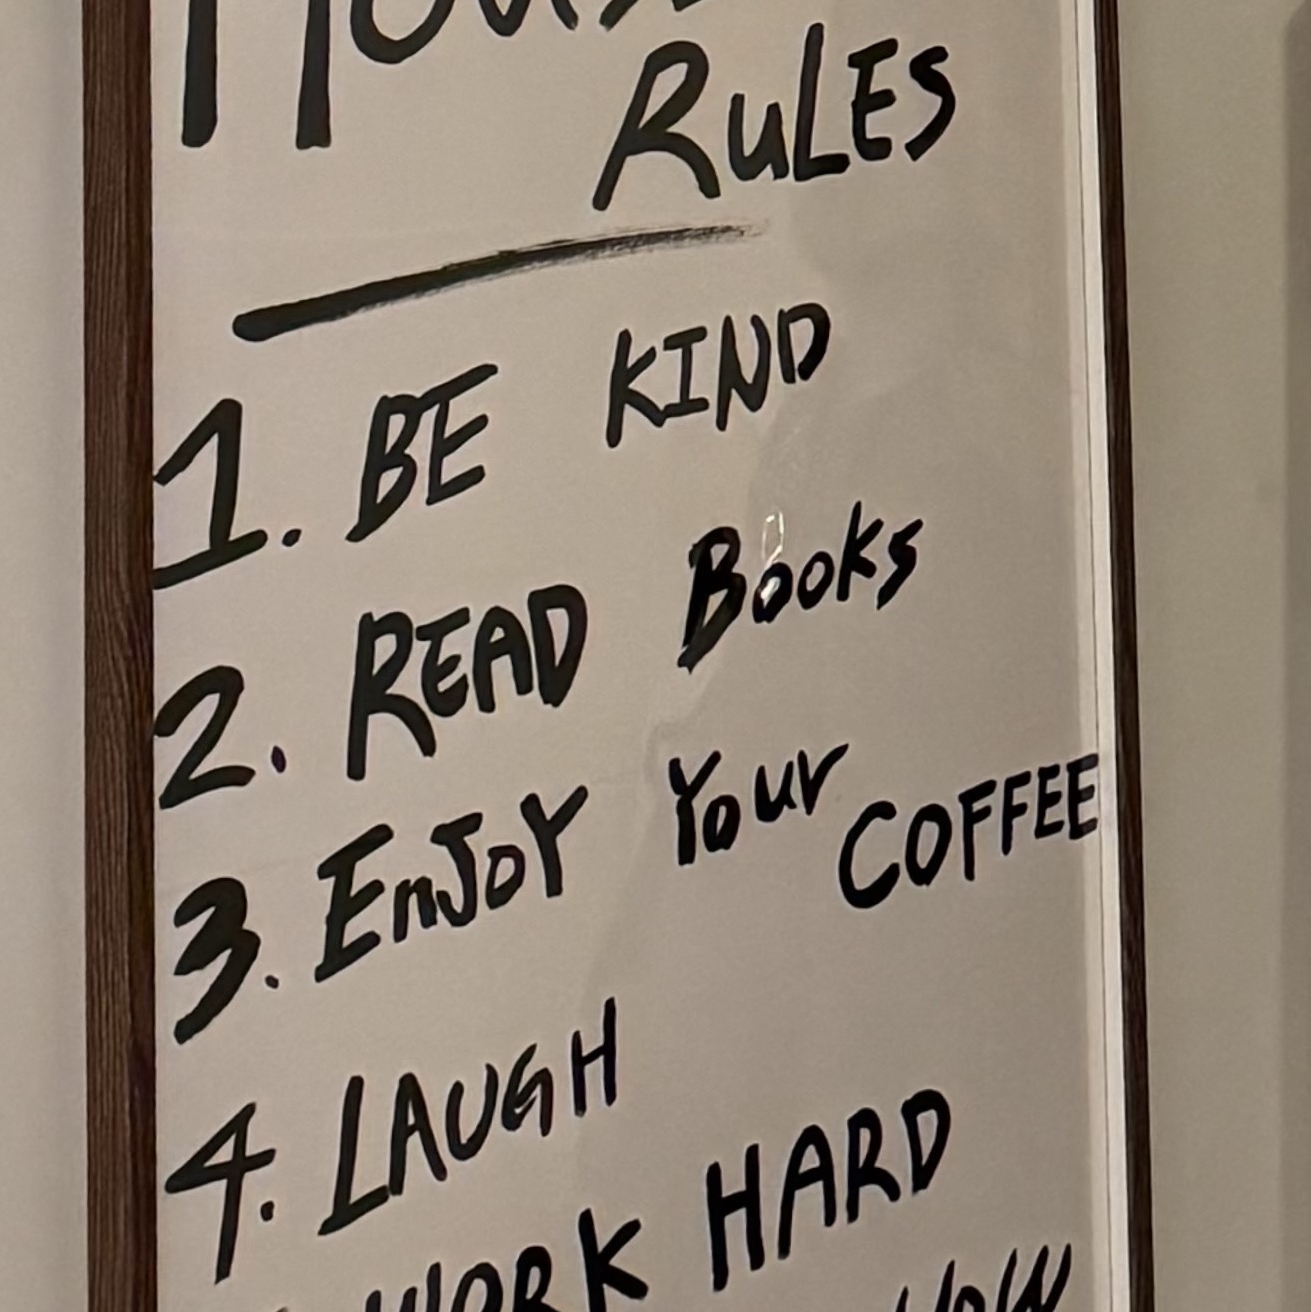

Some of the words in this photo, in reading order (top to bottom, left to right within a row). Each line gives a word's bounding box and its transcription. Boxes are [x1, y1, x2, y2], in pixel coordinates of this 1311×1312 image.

[154, 400, 301, 590] 1.
[346, 364, 498, 542] BE
[606, 303, 830, 448] KIND
[155, 665, 286, 811] 2.
[347, 585, 587, 781] READ
[174, 878, 281, 1044] 3.
[839, 754, 1100, 908] COFFEE
[165, 1103, 276, 1284] 4.
[318, 997, 617, 1235] LAUGH
[706, 1089, 951, 1292] HARD
